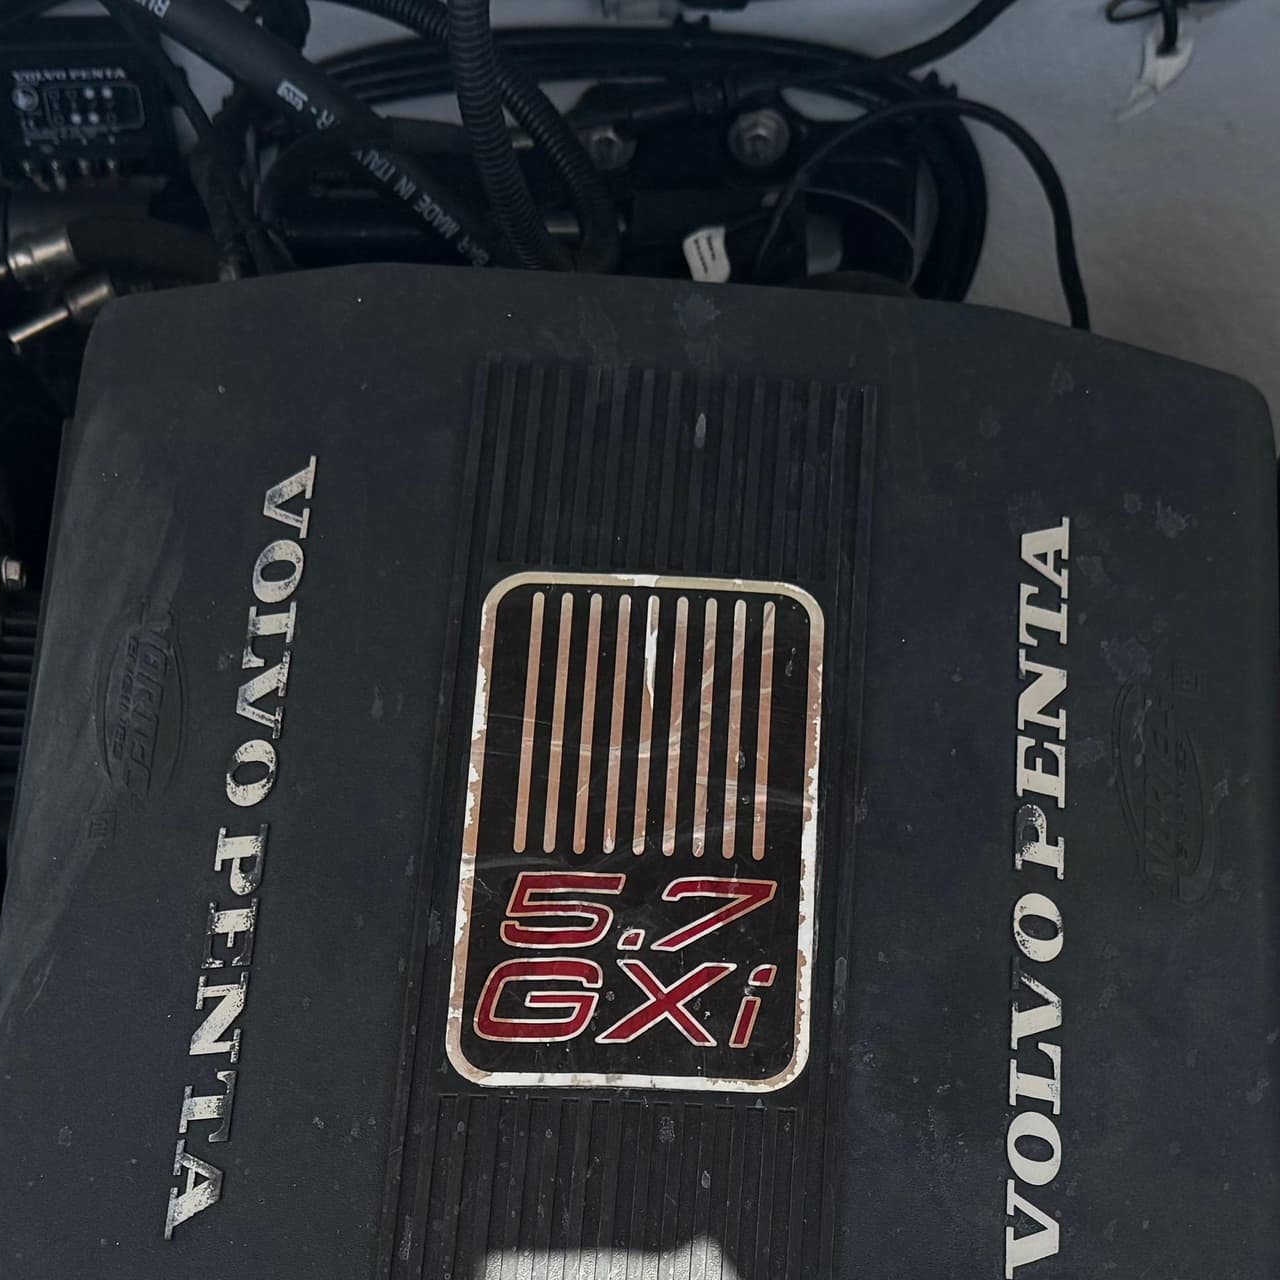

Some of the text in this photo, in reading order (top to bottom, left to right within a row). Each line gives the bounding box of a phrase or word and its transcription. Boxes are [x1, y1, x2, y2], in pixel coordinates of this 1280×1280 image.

[393, 176, 417, 200] IN
[413, 193, 461, 239] MADE
[164, 455, 317, 1240] VOLVO PENTA
[500, 871, 777, 951] 5.7
[1005, 516, 1070, 1280] VOLVO PENTA
[473, 957, 777, 1048] GXi
